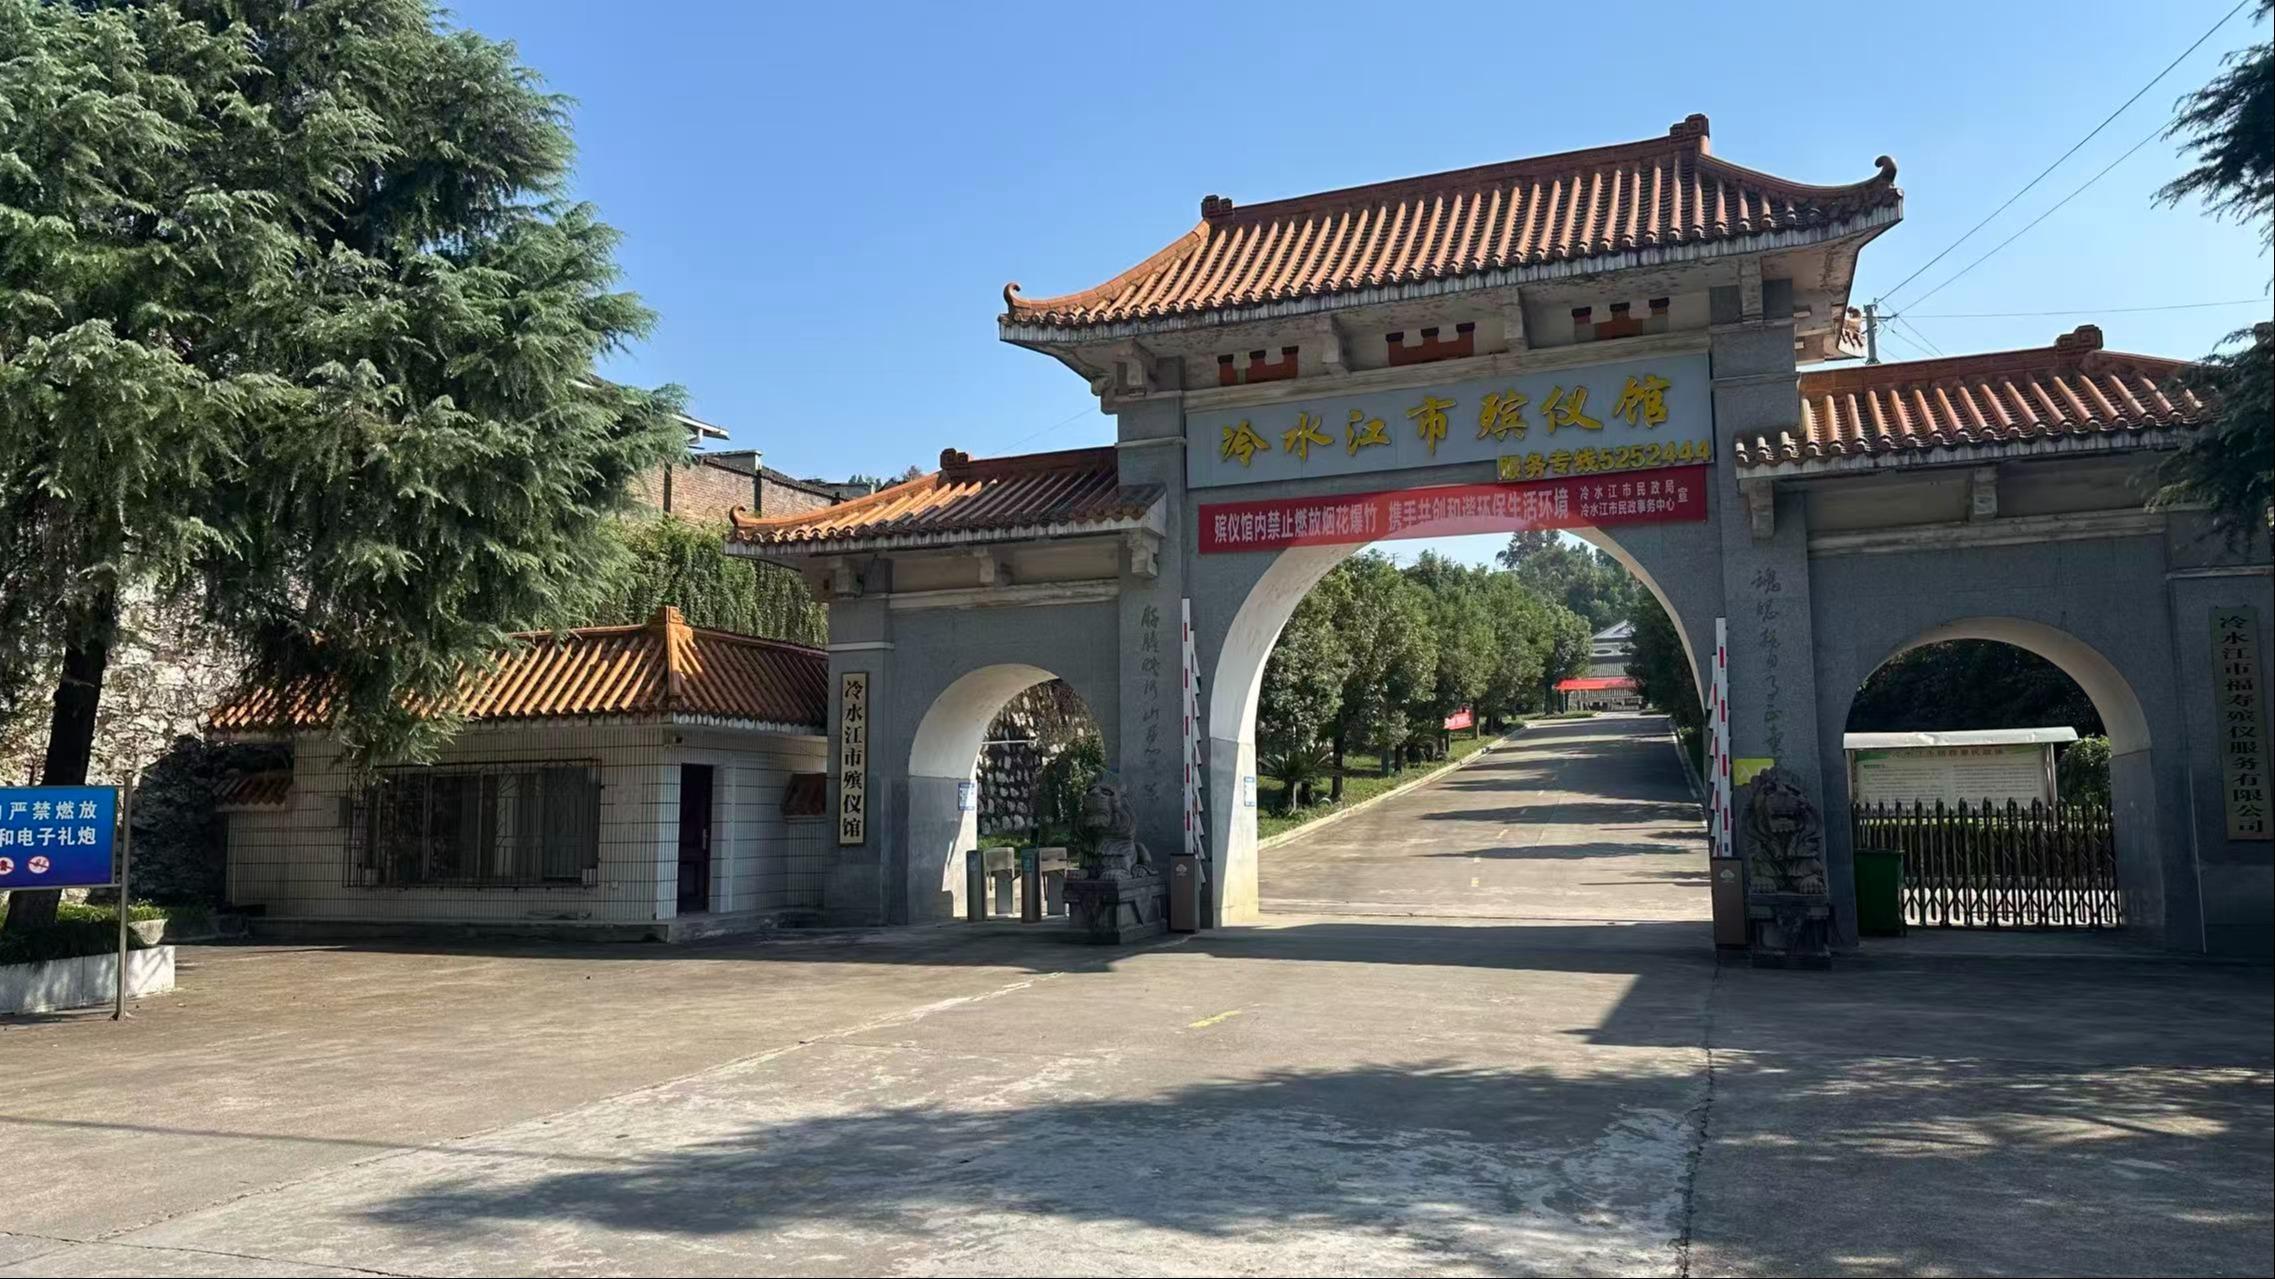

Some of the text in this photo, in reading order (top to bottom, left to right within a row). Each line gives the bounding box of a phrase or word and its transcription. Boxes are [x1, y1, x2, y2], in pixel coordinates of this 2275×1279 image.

[1220, 374, 1672, 468] 冷水江市殡仪馆
[1499, 440, 1711, 481] 服务专线5252444
[1579, 479, 1675, 501] 冷水江市民政局
[1678, 487, 1689, 504] 宣
[1214, 487, 1569, 544] 殡仪馆内禁止燃放烟花爆竹 携手共创和谐环保生活环境
[1580, 497, 1675, 518] 冷水江市民政事务中心
[2219, 615, 2264, 833] 冷水江市福寿殡仪服务有限公司
[842, 679, 864, 838] 冷水江市殡仪馆
[0, 800, 97, 820] 严禁燃放
[0, 826, 97, 847] 和电子礼炮
